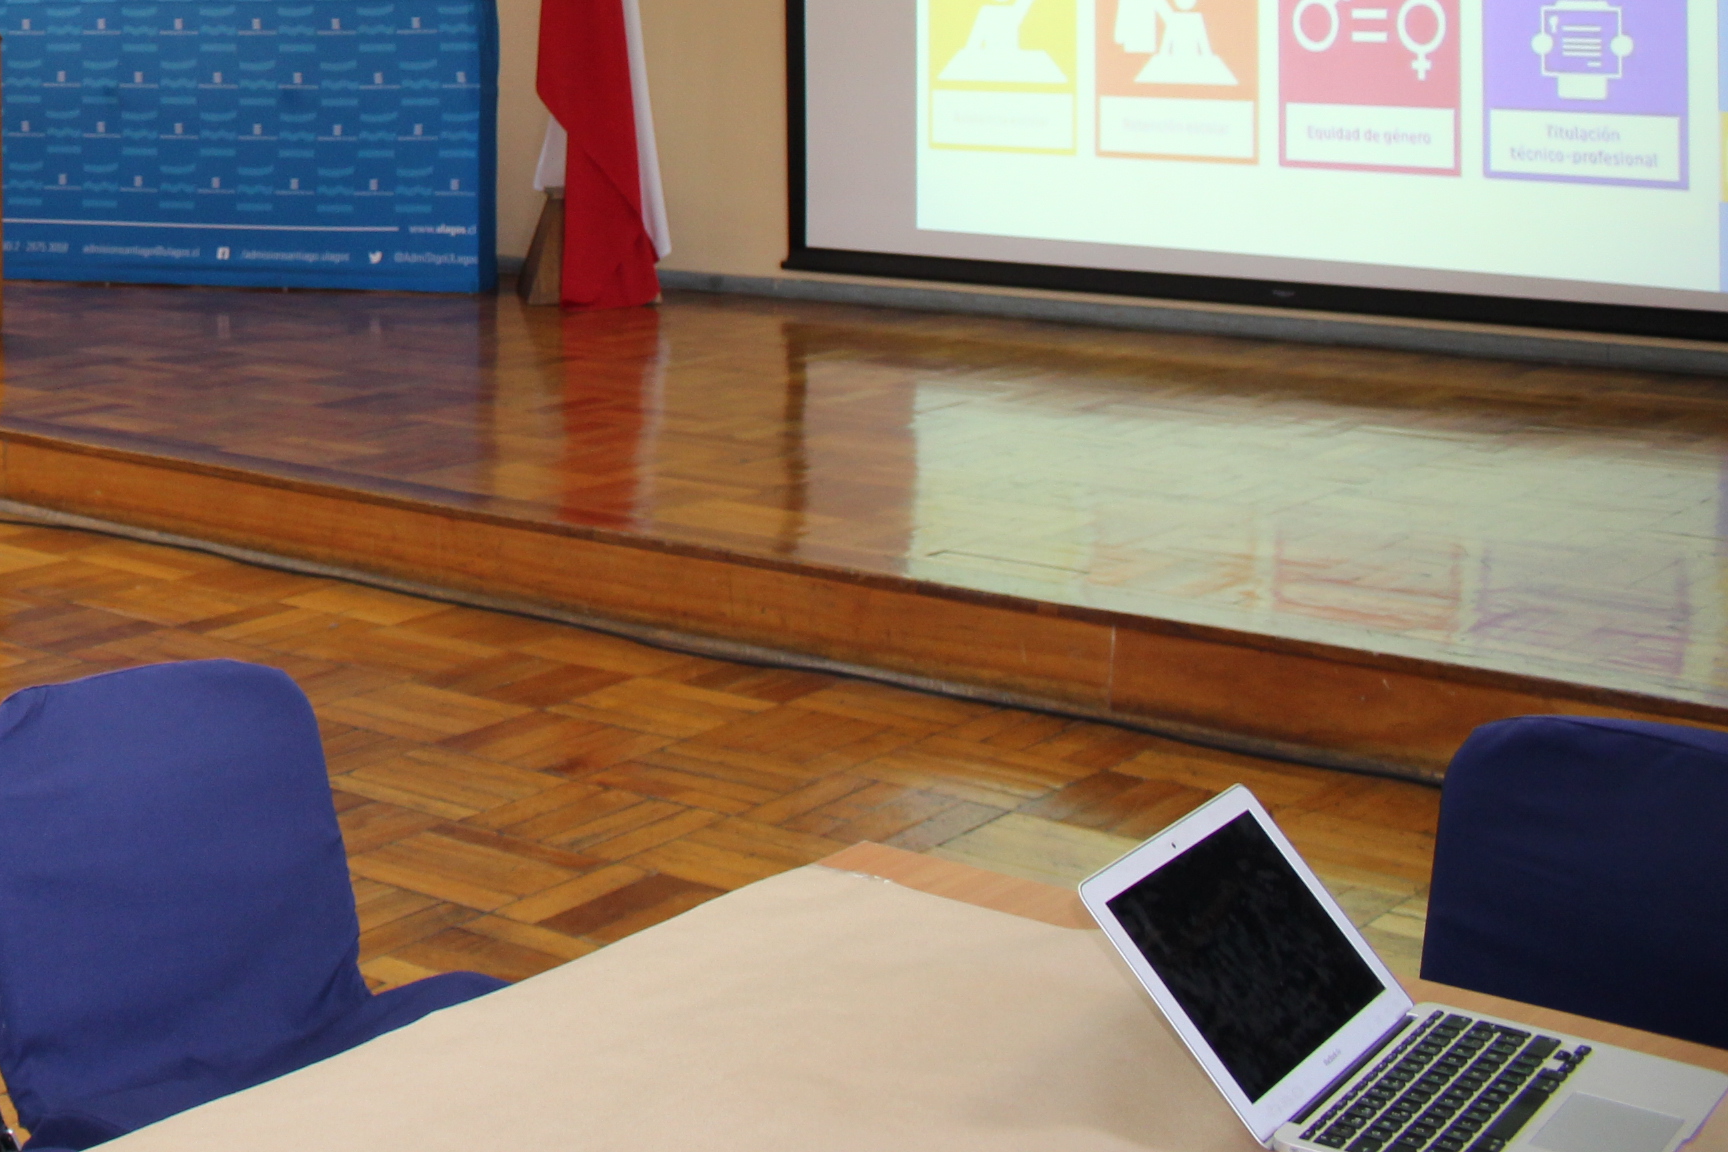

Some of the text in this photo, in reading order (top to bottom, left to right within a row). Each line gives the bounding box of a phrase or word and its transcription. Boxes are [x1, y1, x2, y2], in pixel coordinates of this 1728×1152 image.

[1307, 125, 1361, 142] Equidad
[1363, 129, 1382, 143] de
[1546, 124, 1621, 142] Titulación
